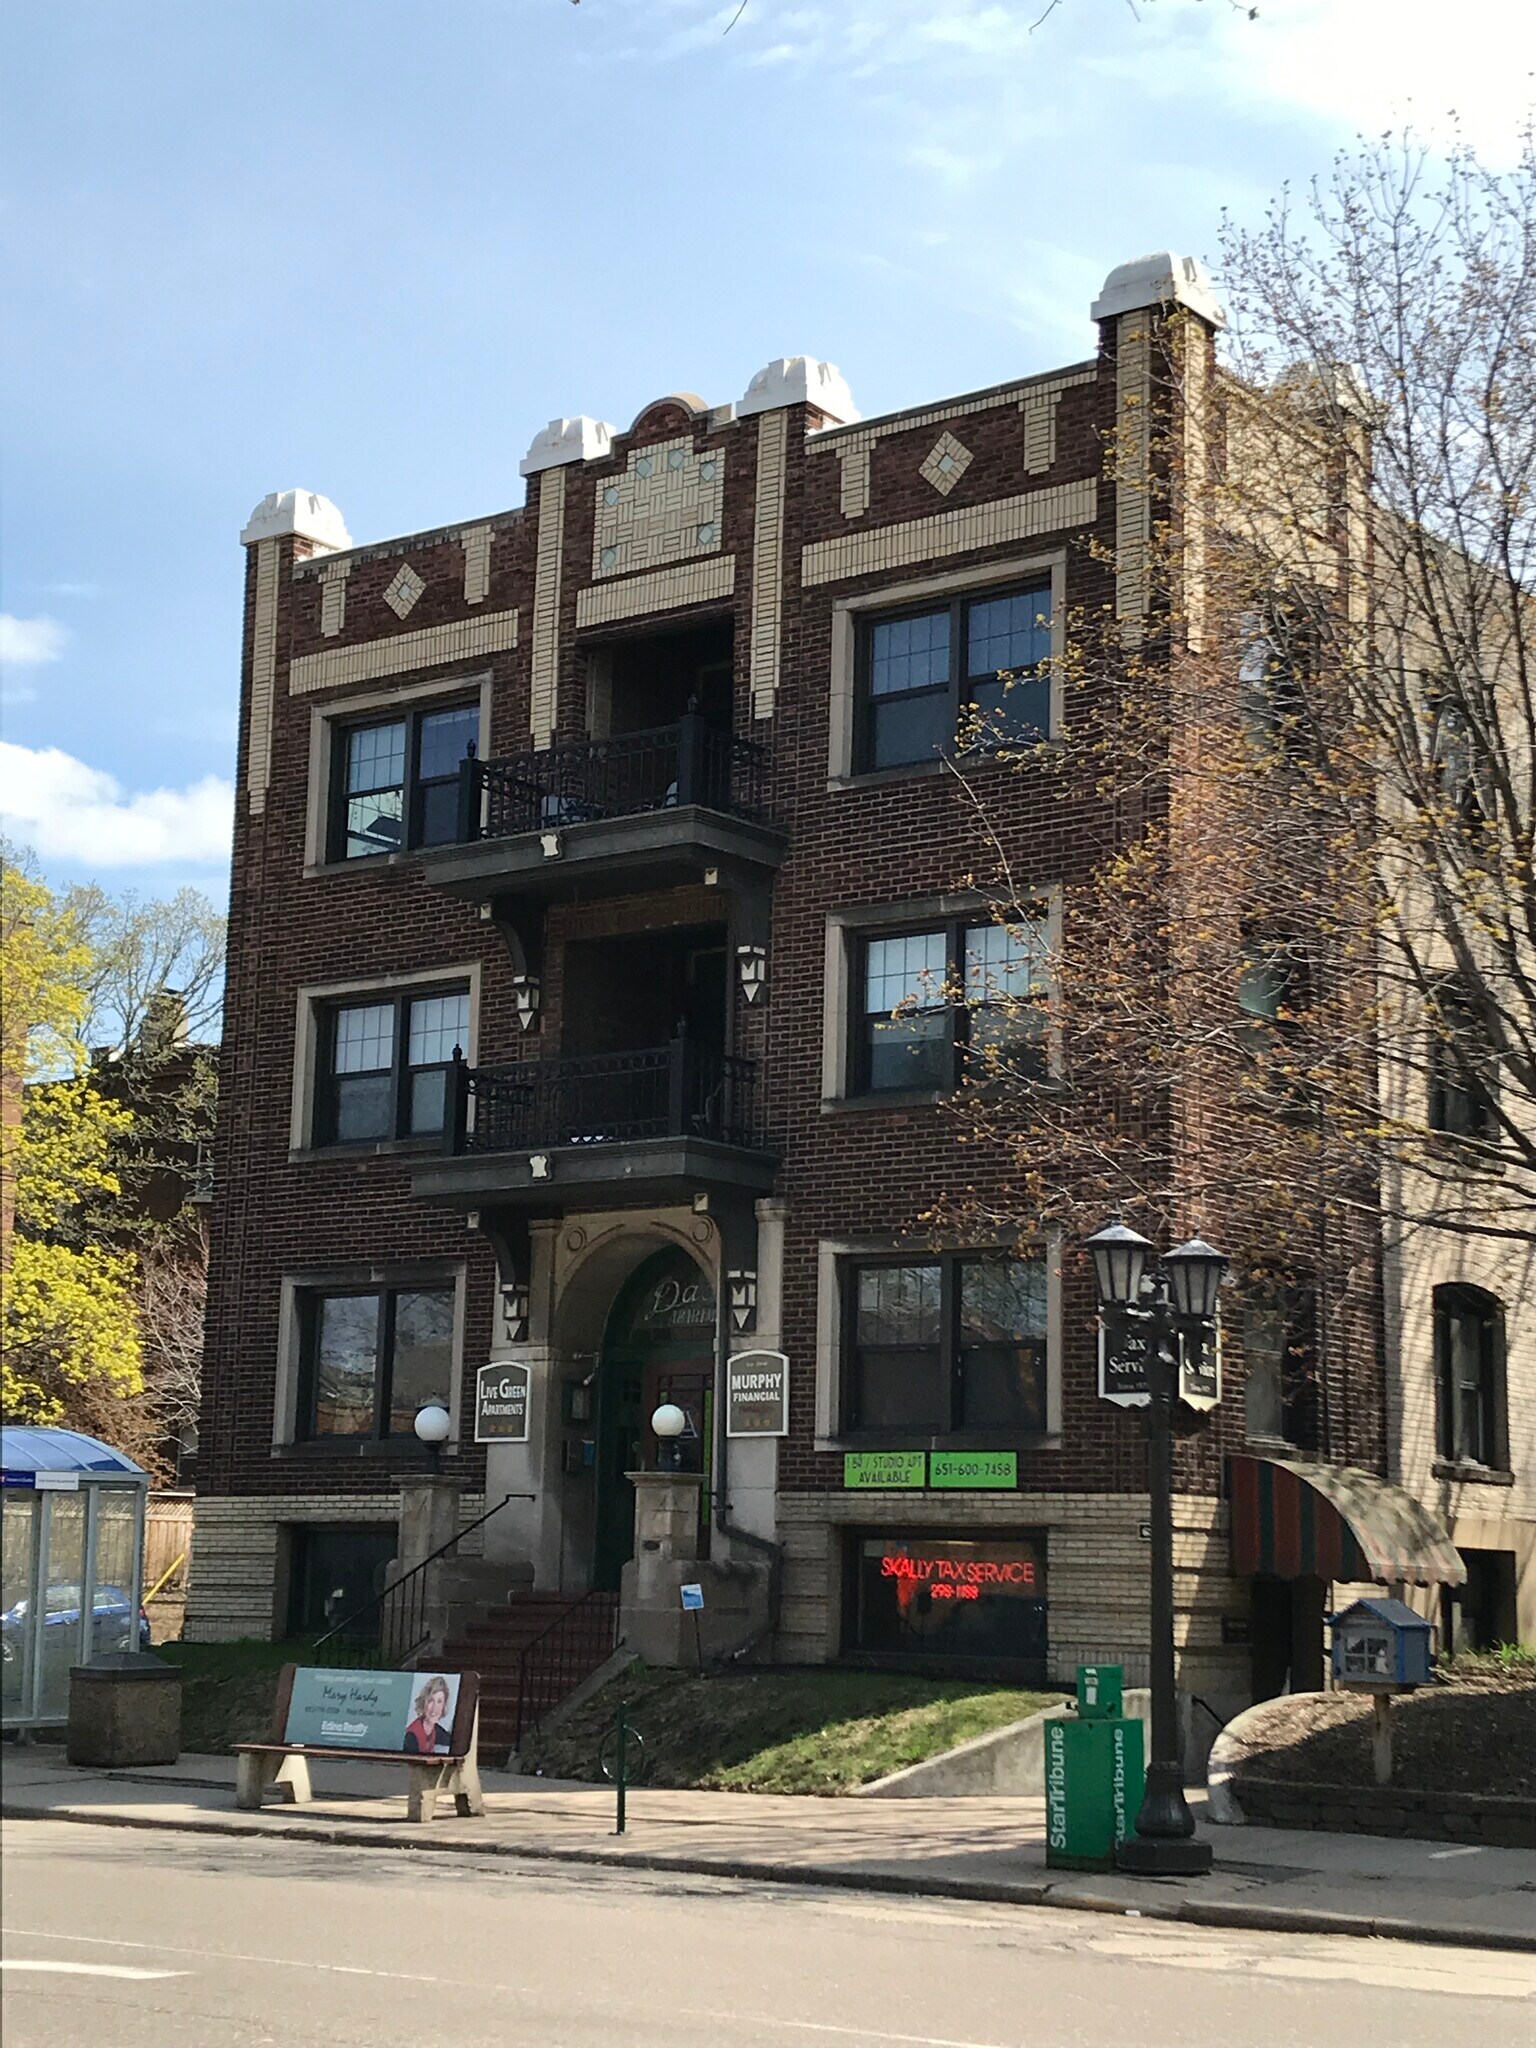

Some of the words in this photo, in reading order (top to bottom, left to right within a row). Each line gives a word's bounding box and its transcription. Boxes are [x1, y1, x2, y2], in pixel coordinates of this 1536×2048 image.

[1108, 1356, 1145, 1375] Servi
[731, 1372, 782, 1391] MURPHY
[732, 1391, 781, 1402] FINANCIAL
[873, 1456, 904, 1469] STUDIO
[934, 1463, 1012, 1477] 651-600-7458
[859, 1470, 912, 1484] AVAILABLE
[935, 1560, 966, 1580] TAX
[966, 1562, 1034, 1583] SERVICE
[323, 1686, 347, 1705] Mary
[349, 1687, 379, 1706] Hardy
[321, 1720, 343, 1732] Edina
[343, 1722, 368, 1735] Realty
[1050, 1726, 1066, 1849] StarTribune
